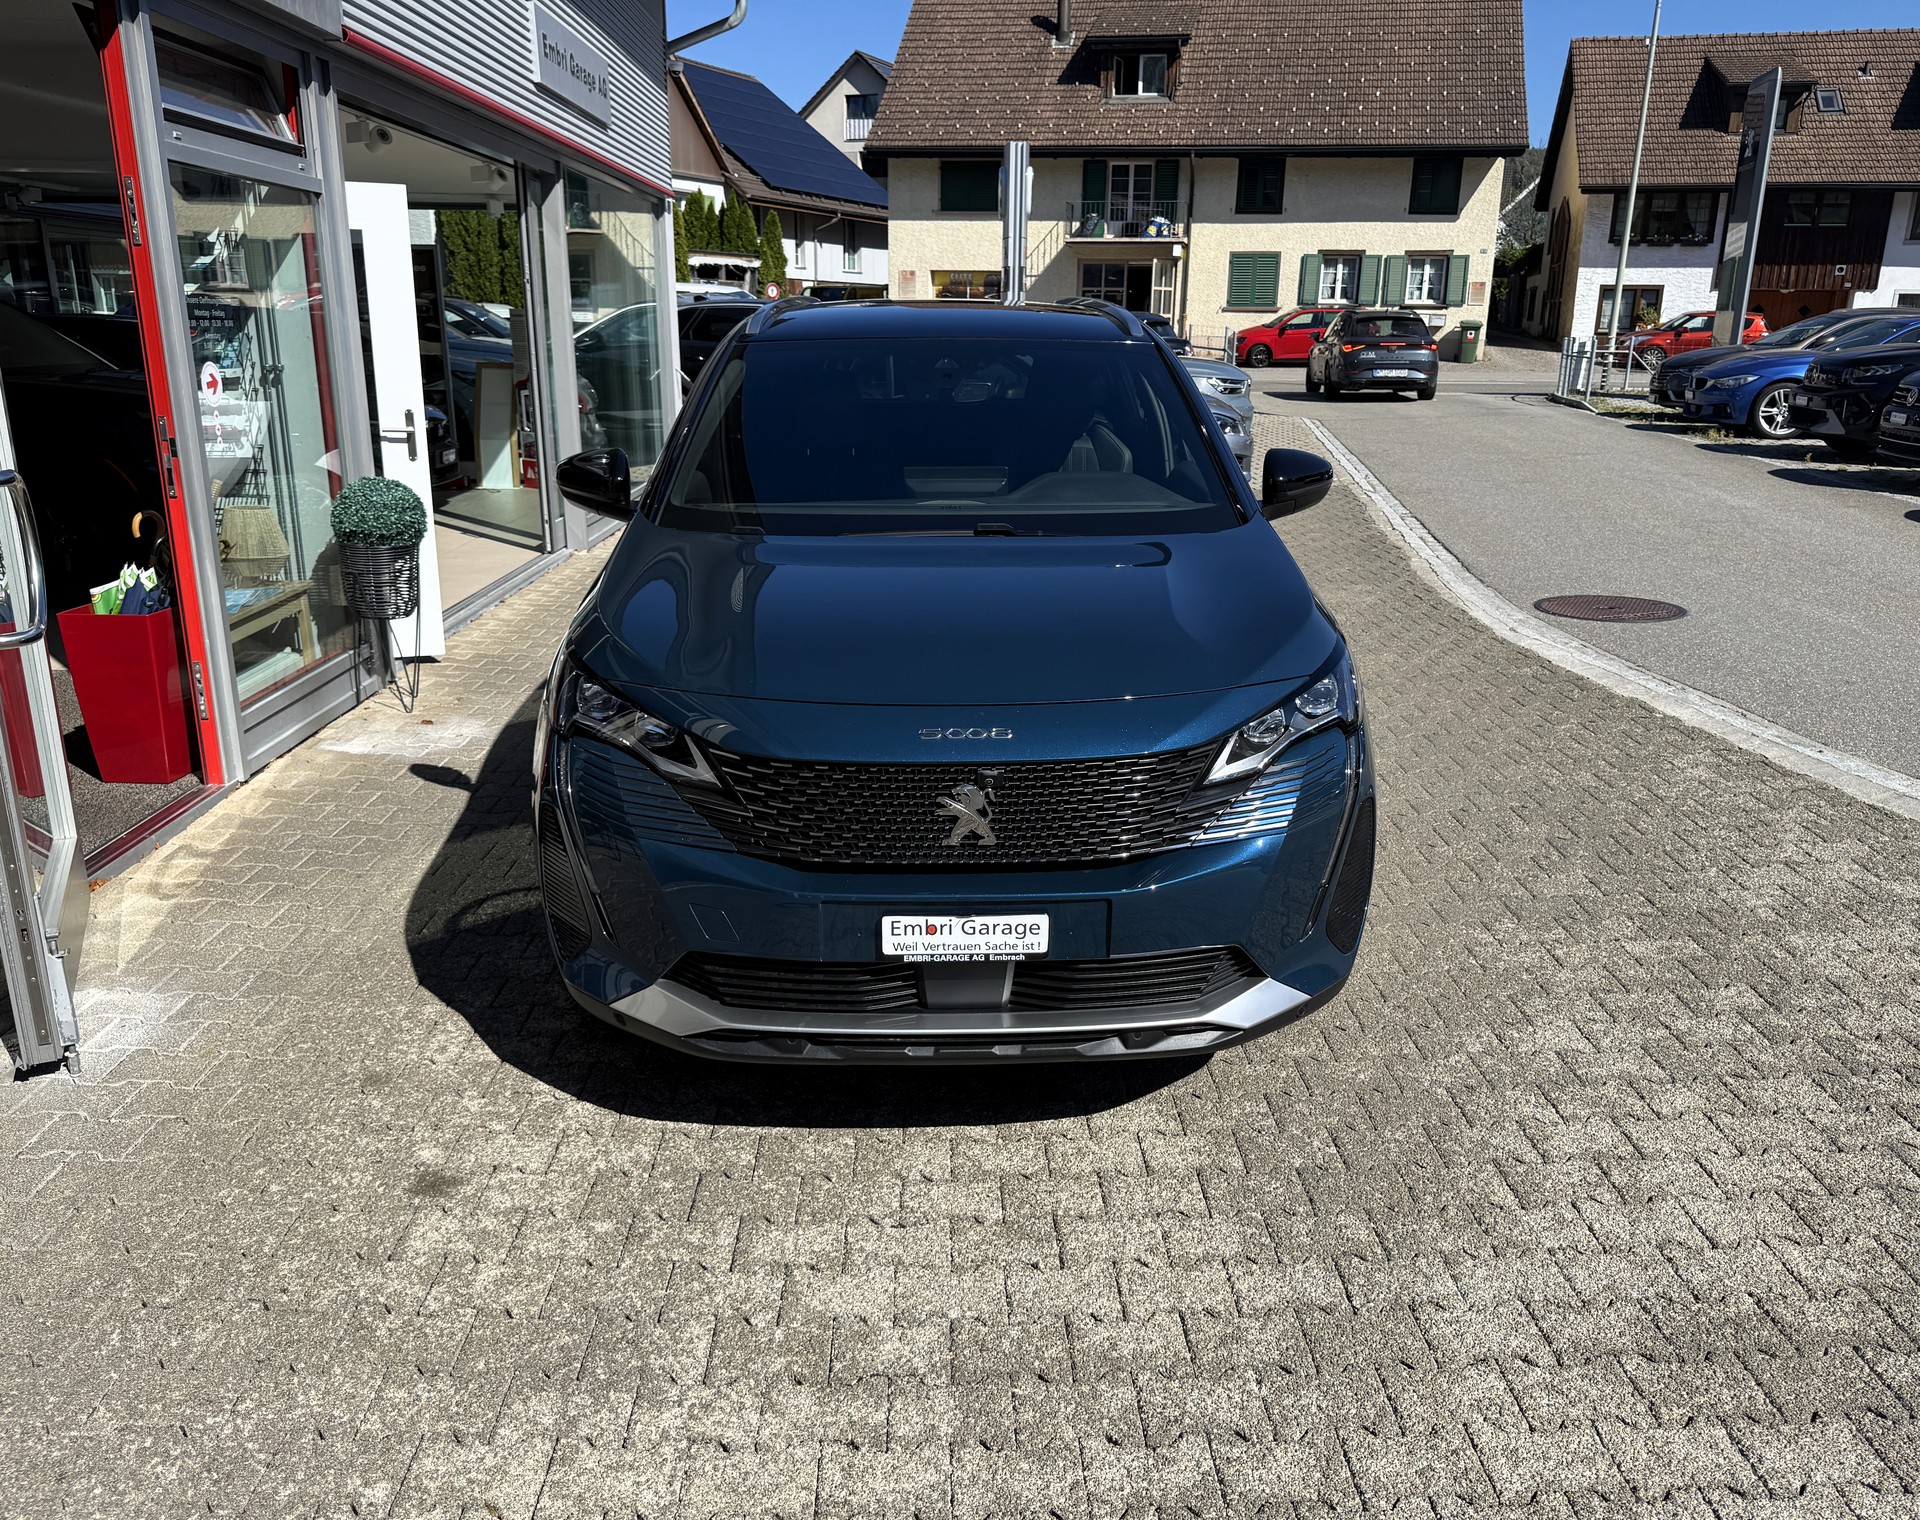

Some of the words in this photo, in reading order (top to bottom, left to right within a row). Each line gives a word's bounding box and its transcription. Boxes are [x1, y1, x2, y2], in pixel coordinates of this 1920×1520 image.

[542, 32, 567, 72] Embri
[569, 52, 596, 93] Garage
[598, 74, 608, 99] AG
[919, 728, 1013, 740] 5008
[891, 919, 953, 937] Embri
[961, 919, 1041, 940] Garage
[892, 942, 918, 951] Weil
[921, 942, 981, 951] Vertrauen
[985, 941, 1018, 951] Sache
[1022, 941, 1035, 951] ist
[903, 954, 970, 962] EMBRI-GARAGE
